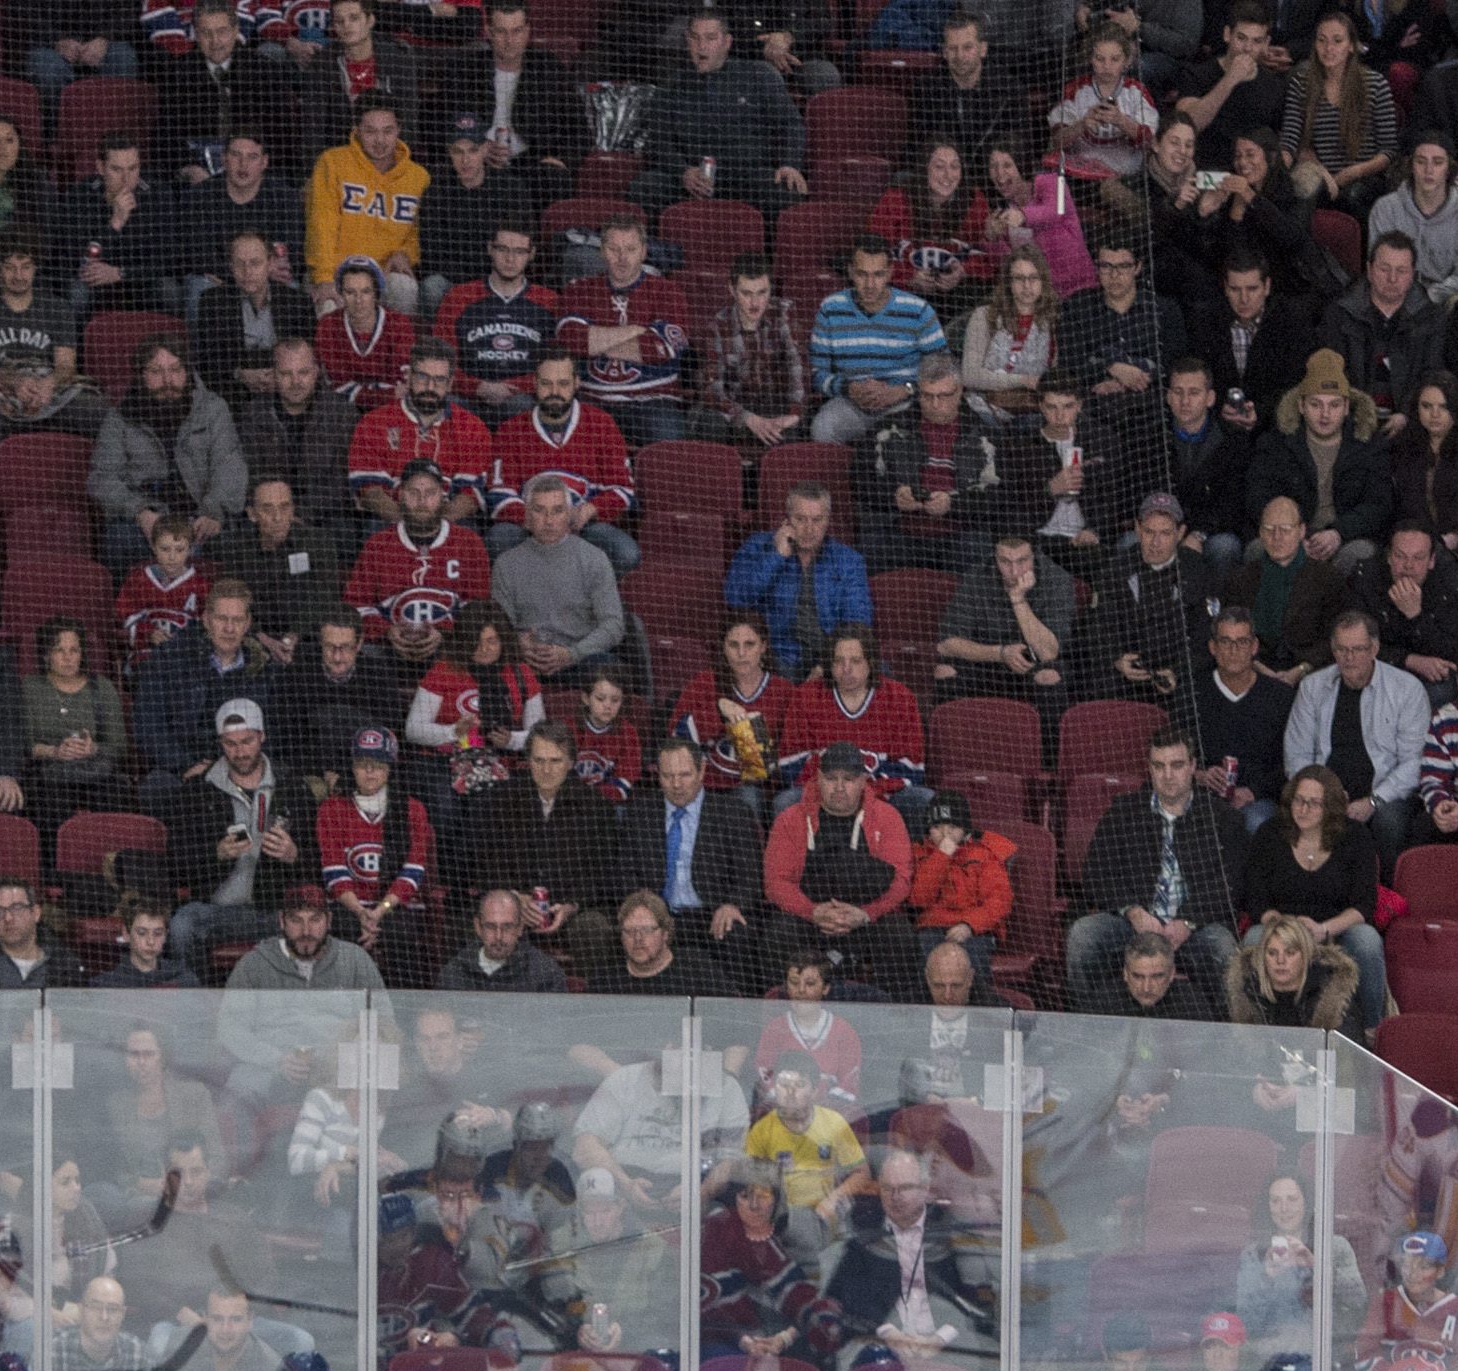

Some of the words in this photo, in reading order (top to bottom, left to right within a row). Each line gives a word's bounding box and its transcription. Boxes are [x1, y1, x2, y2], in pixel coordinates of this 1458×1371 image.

[466, 322, 542, 342] CANADIENS
[476, 349, 530, 361] HOCKEY
[446, 559, 460, 579] C
[1442, 1315, 1456, 1341] A
